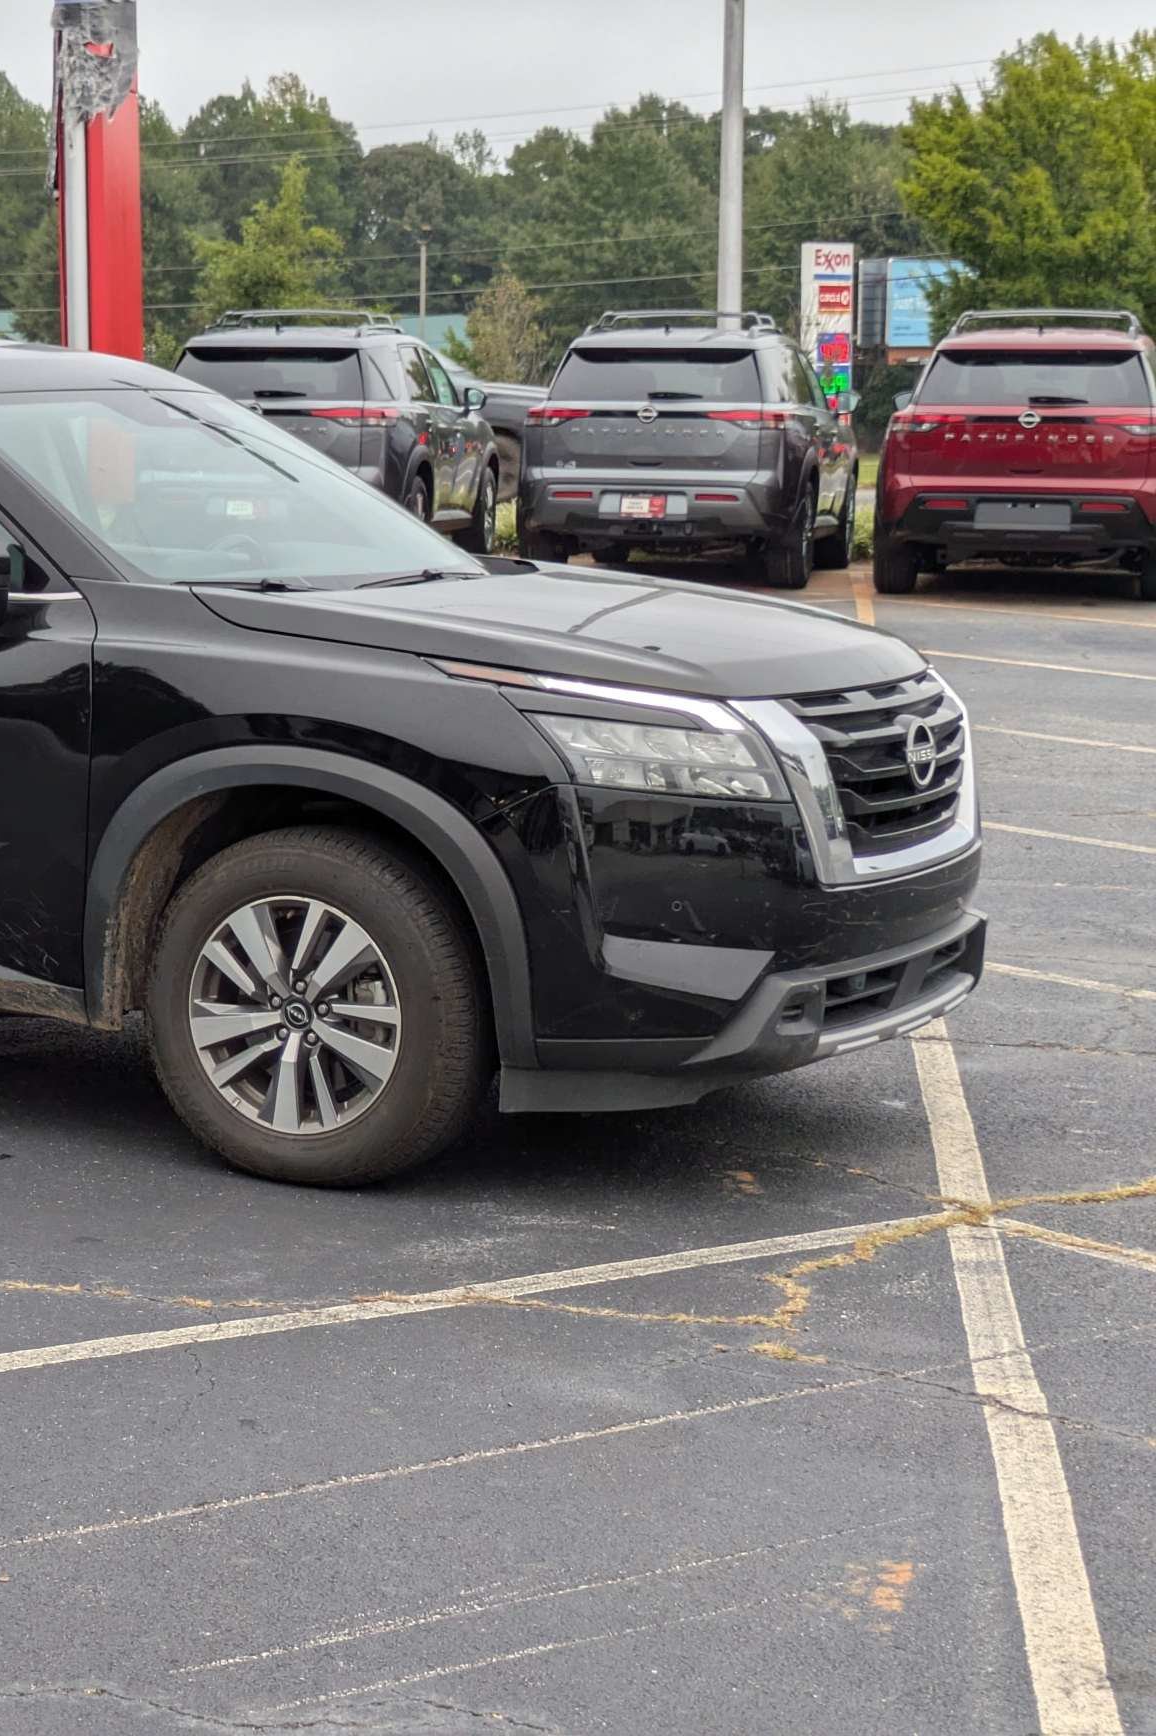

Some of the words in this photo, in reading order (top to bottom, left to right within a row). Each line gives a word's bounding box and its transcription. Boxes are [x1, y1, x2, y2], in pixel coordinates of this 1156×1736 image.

[814, 248, 851, 272] Exxon
[944, 432, 1114, 443] PATHFINDER
[907, 748, 933, 763] NISS
